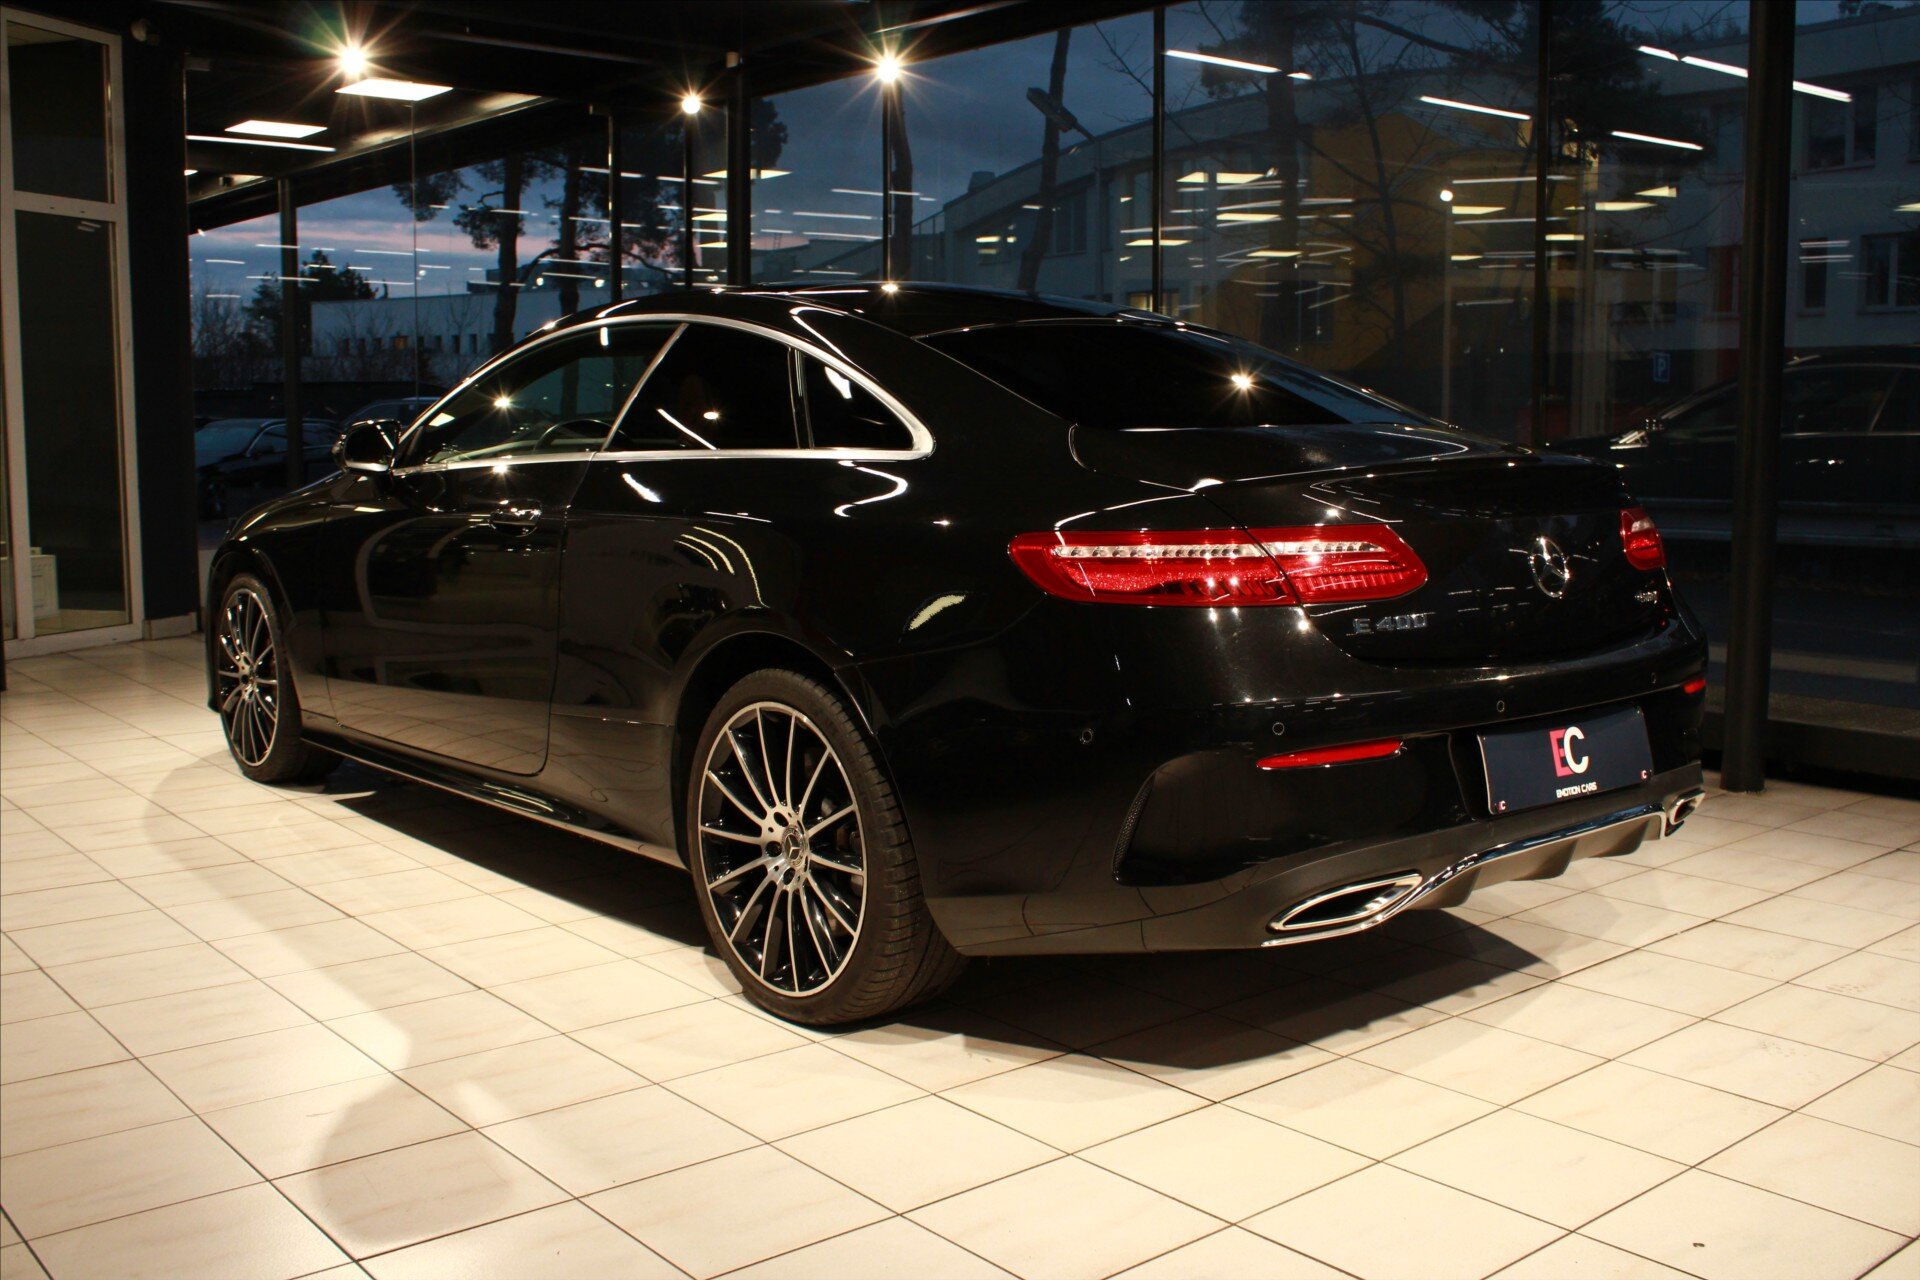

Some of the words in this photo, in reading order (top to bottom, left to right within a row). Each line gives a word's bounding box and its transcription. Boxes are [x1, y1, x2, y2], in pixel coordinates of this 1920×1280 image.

[1353, 618, 1372, 634] E
[1376, 613, 1428, 631] 400
[1549, 726, 1589, 777] EC
